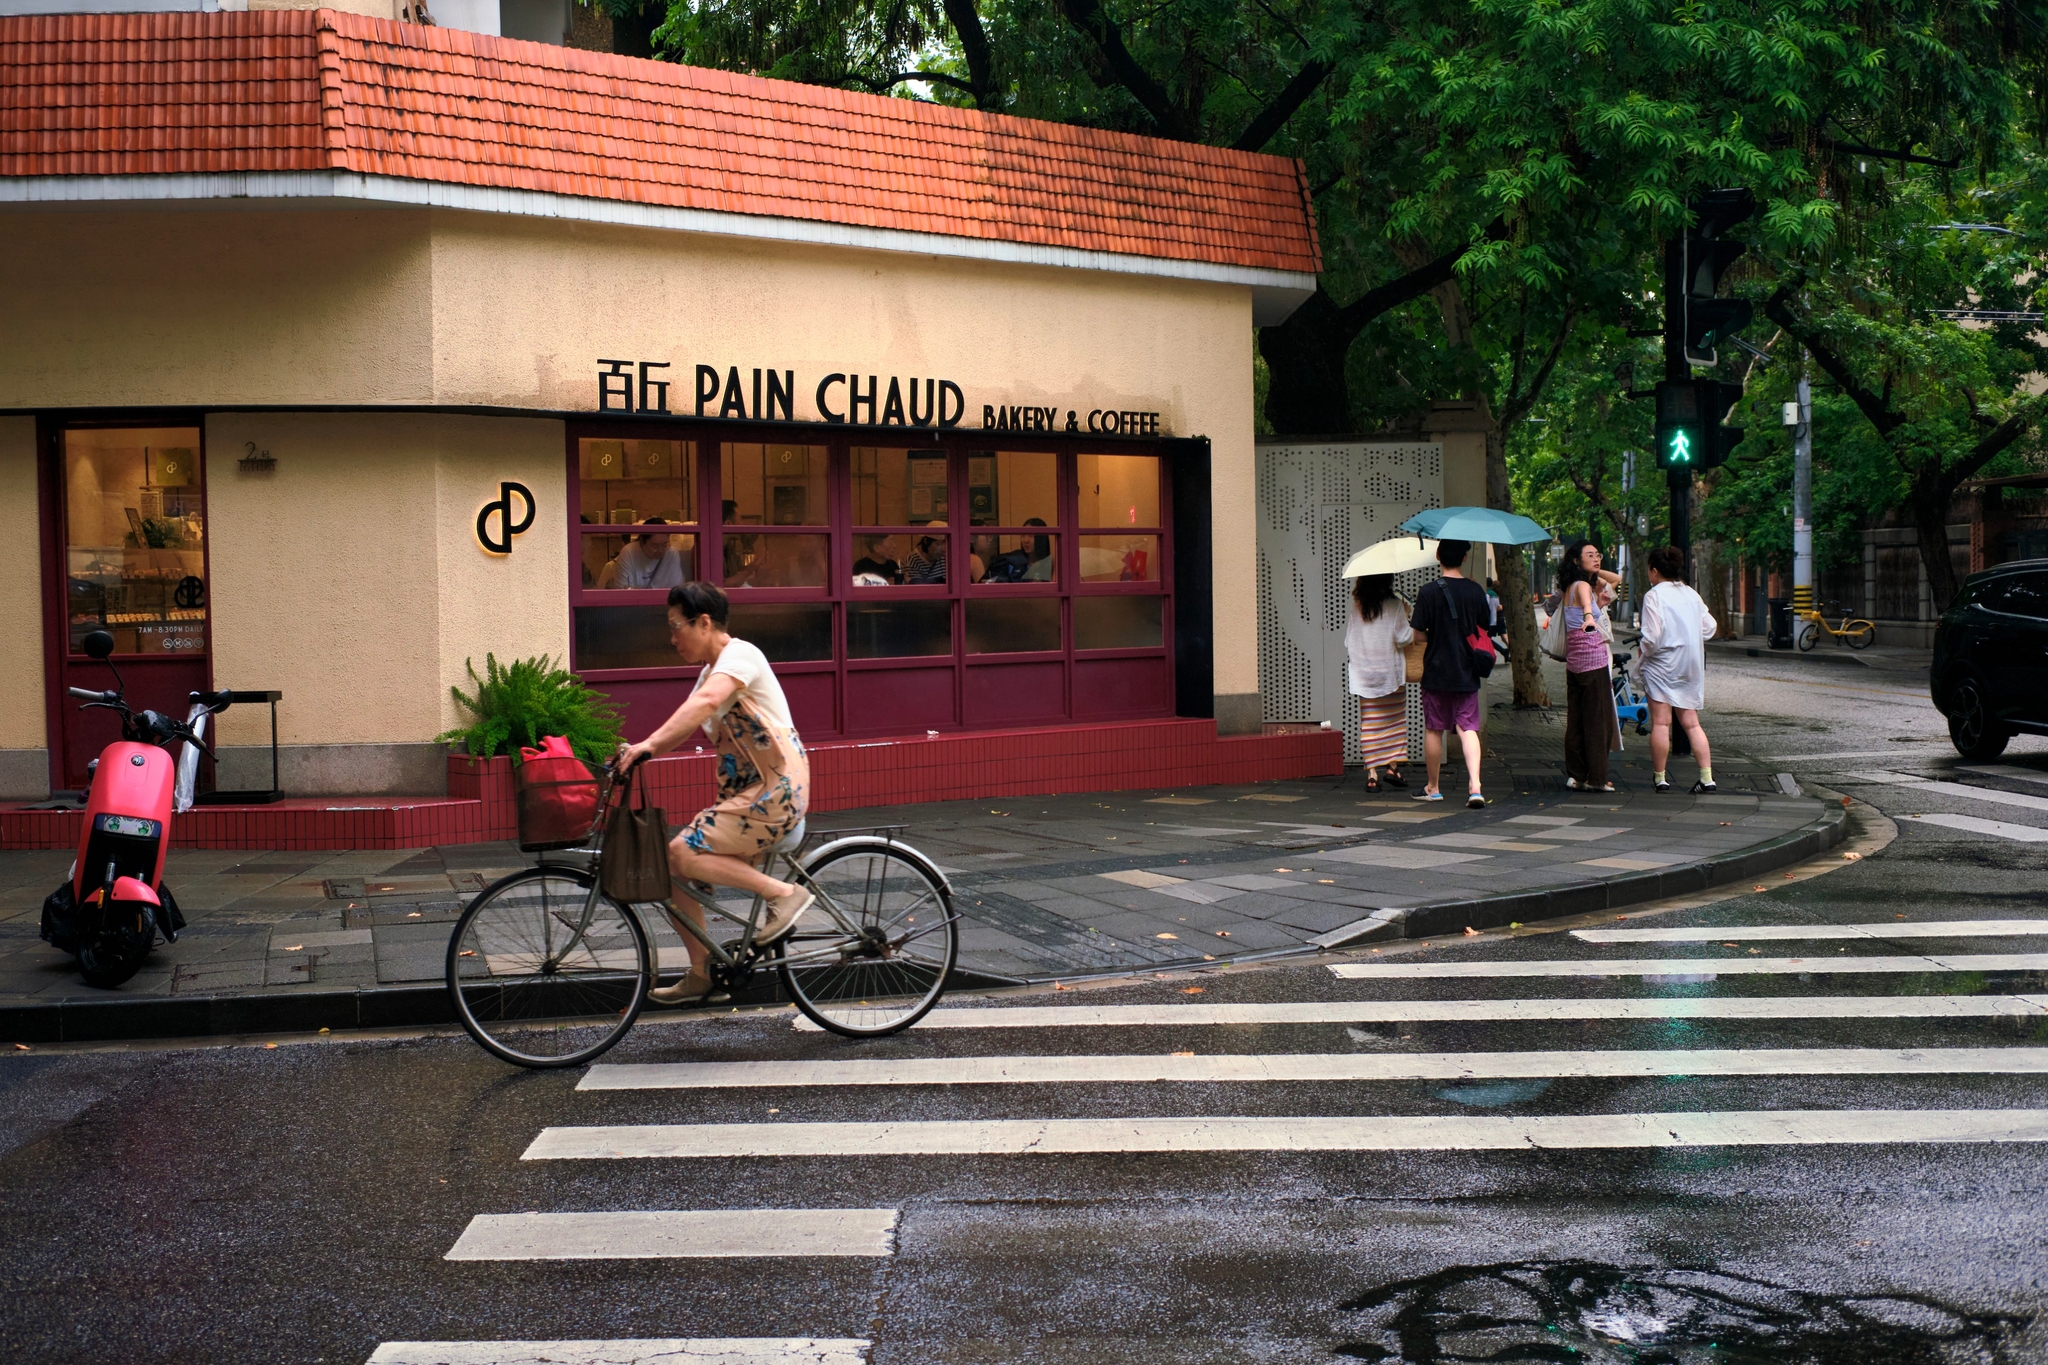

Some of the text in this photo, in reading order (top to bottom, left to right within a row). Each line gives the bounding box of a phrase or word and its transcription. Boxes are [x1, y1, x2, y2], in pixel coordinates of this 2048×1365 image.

[694, 363, 965, 428] PAIN CHAUD
[982, 404, 1160, 437] BAKERY & COFFEE
[138, 626, 153, 634] 7AM
